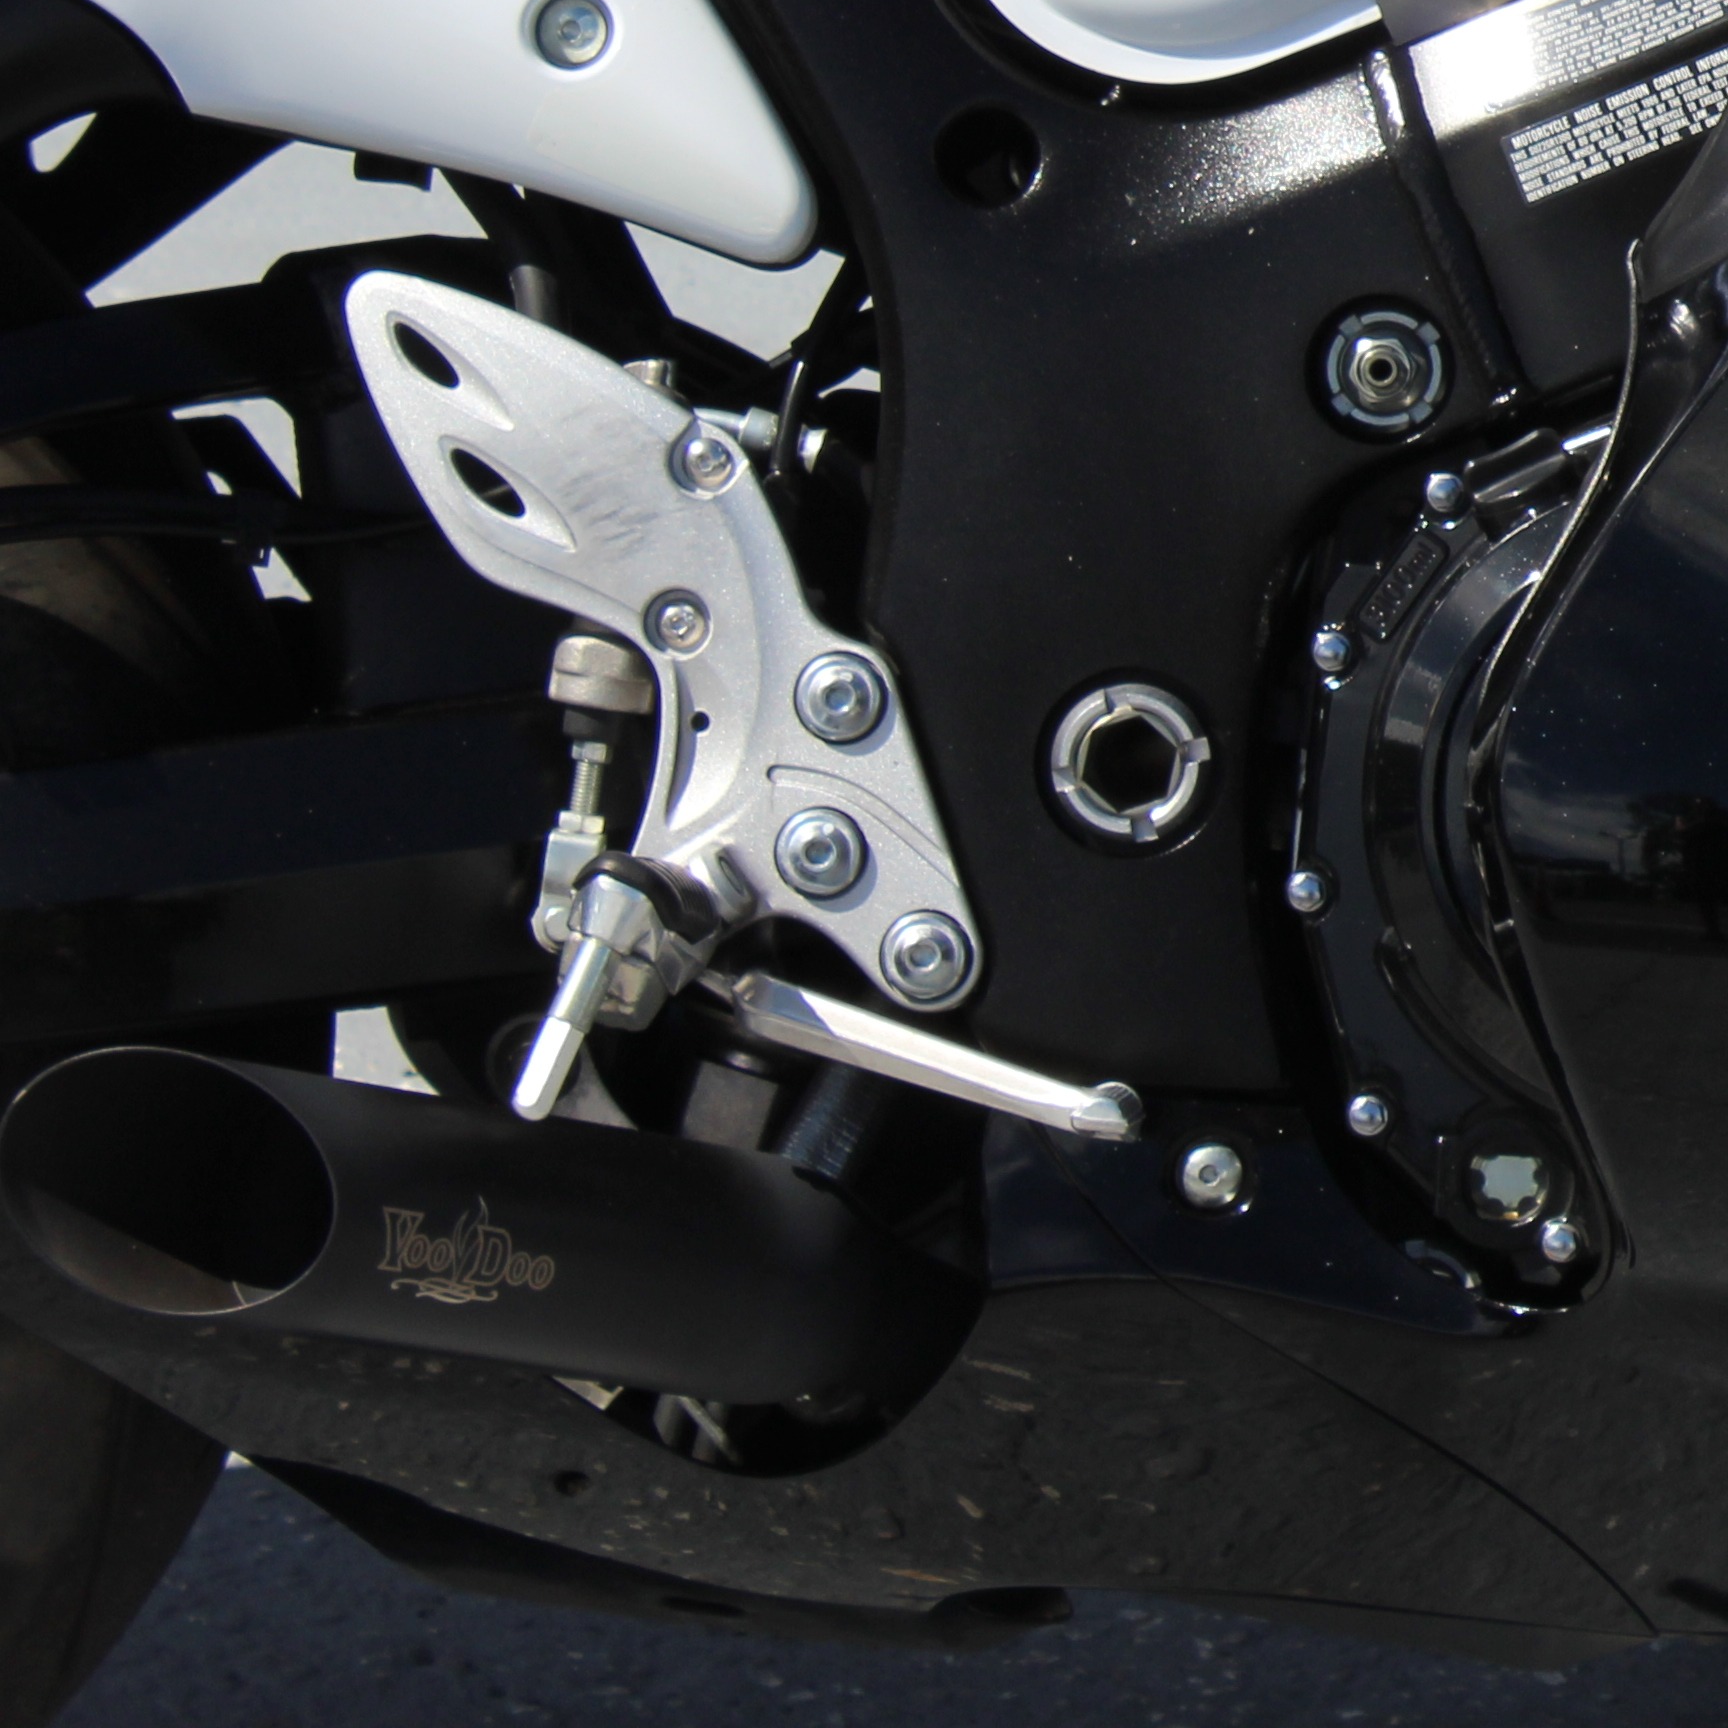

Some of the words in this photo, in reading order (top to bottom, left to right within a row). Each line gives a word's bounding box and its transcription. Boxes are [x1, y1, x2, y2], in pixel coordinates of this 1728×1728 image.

[1510, 115, 1571, 149] MOTORCYCLE
[1573, 102, 1603, 124] NOISE
[1604, 82, 1650, 110] EMISSION
[1651, 64, 1693, 91] CONTROL
